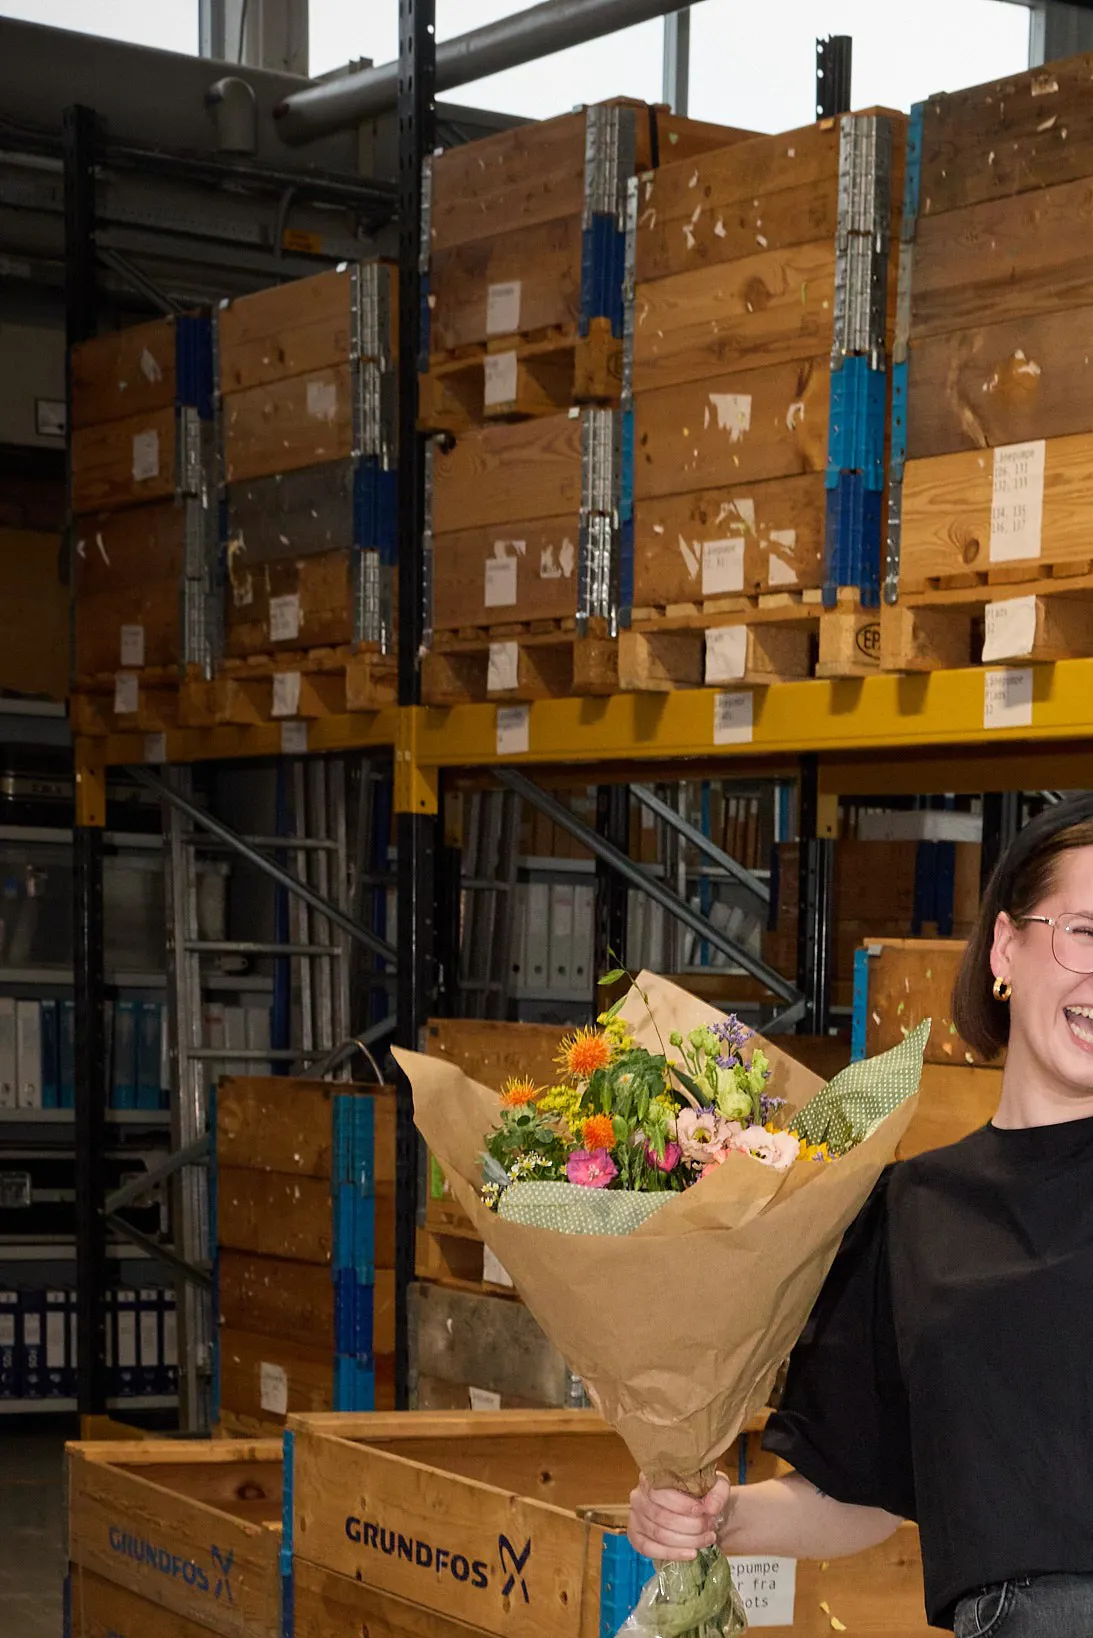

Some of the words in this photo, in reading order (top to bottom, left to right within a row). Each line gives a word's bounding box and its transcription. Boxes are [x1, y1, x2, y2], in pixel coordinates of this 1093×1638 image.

[108, 1525, 210, 1592] GRUNDFOS
[345, 1516, 489, 1589] GRUNDFOS
[753, 1579, 777, 1591] fra
